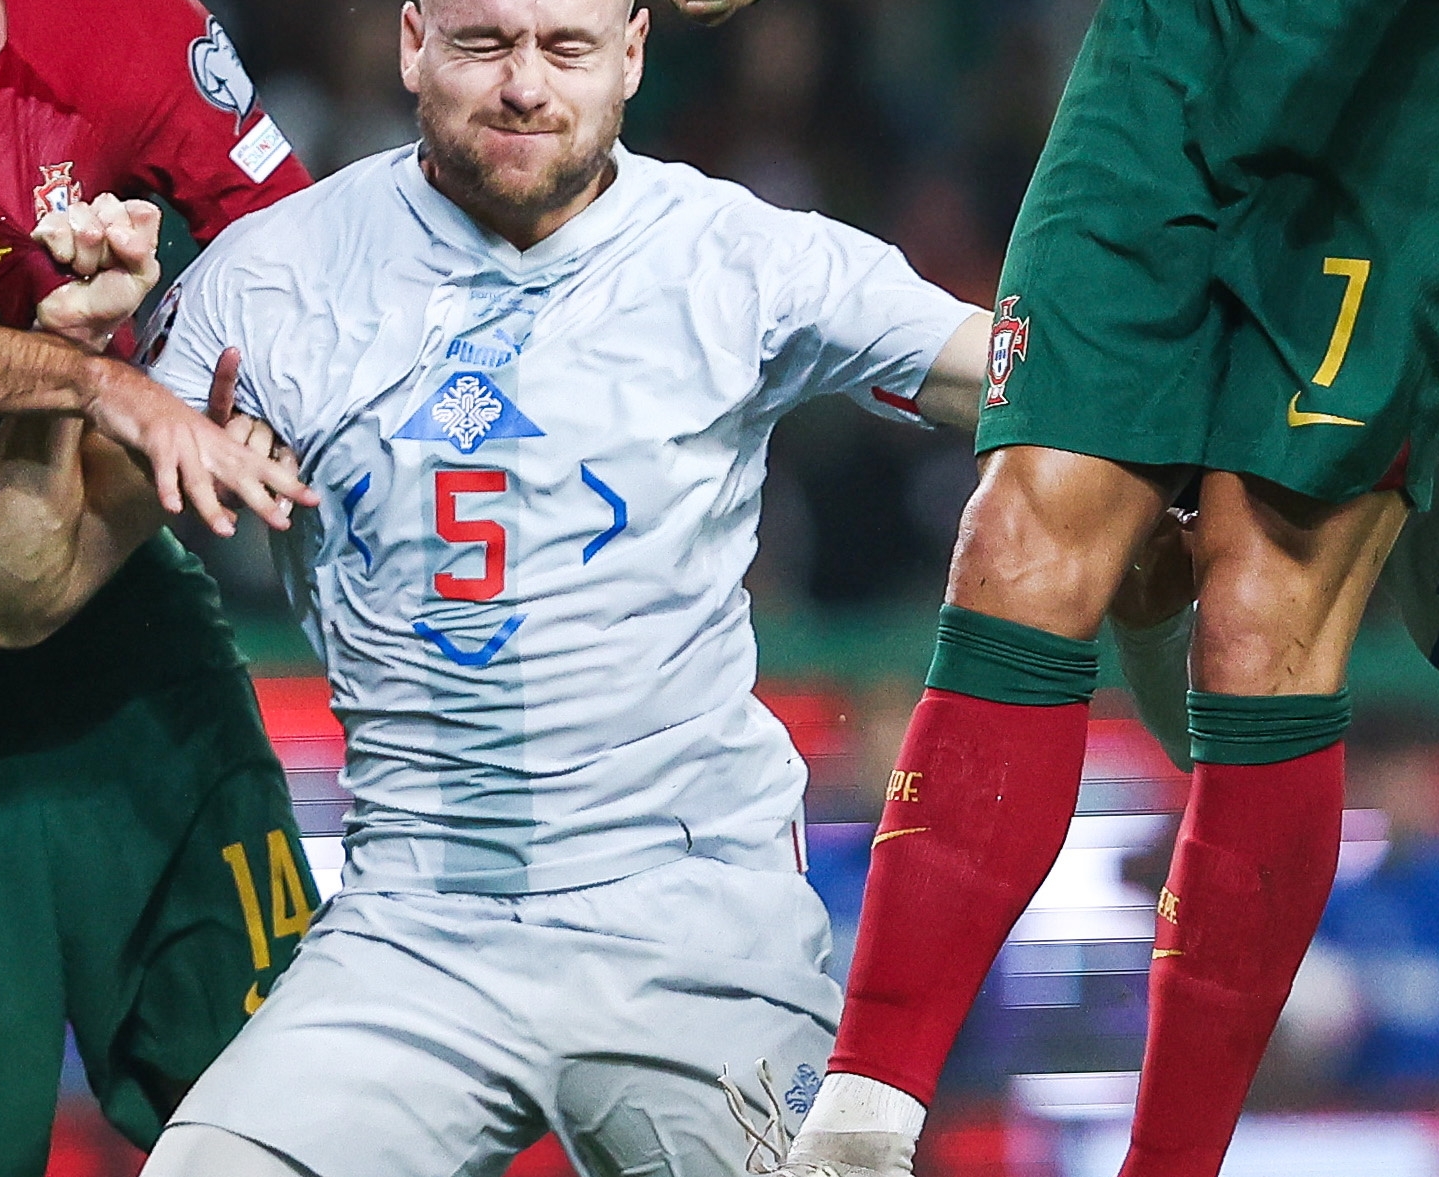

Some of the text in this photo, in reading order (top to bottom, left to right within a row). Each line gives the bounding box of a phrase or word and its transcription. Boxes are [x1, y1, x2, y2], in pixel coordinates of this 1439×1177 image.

[446, 338, 511, 367] PUMA
[1311, 257, 1371, 387] 7
[434, 471, 506, 601] 5
[222, 829, 316, 969] 14
